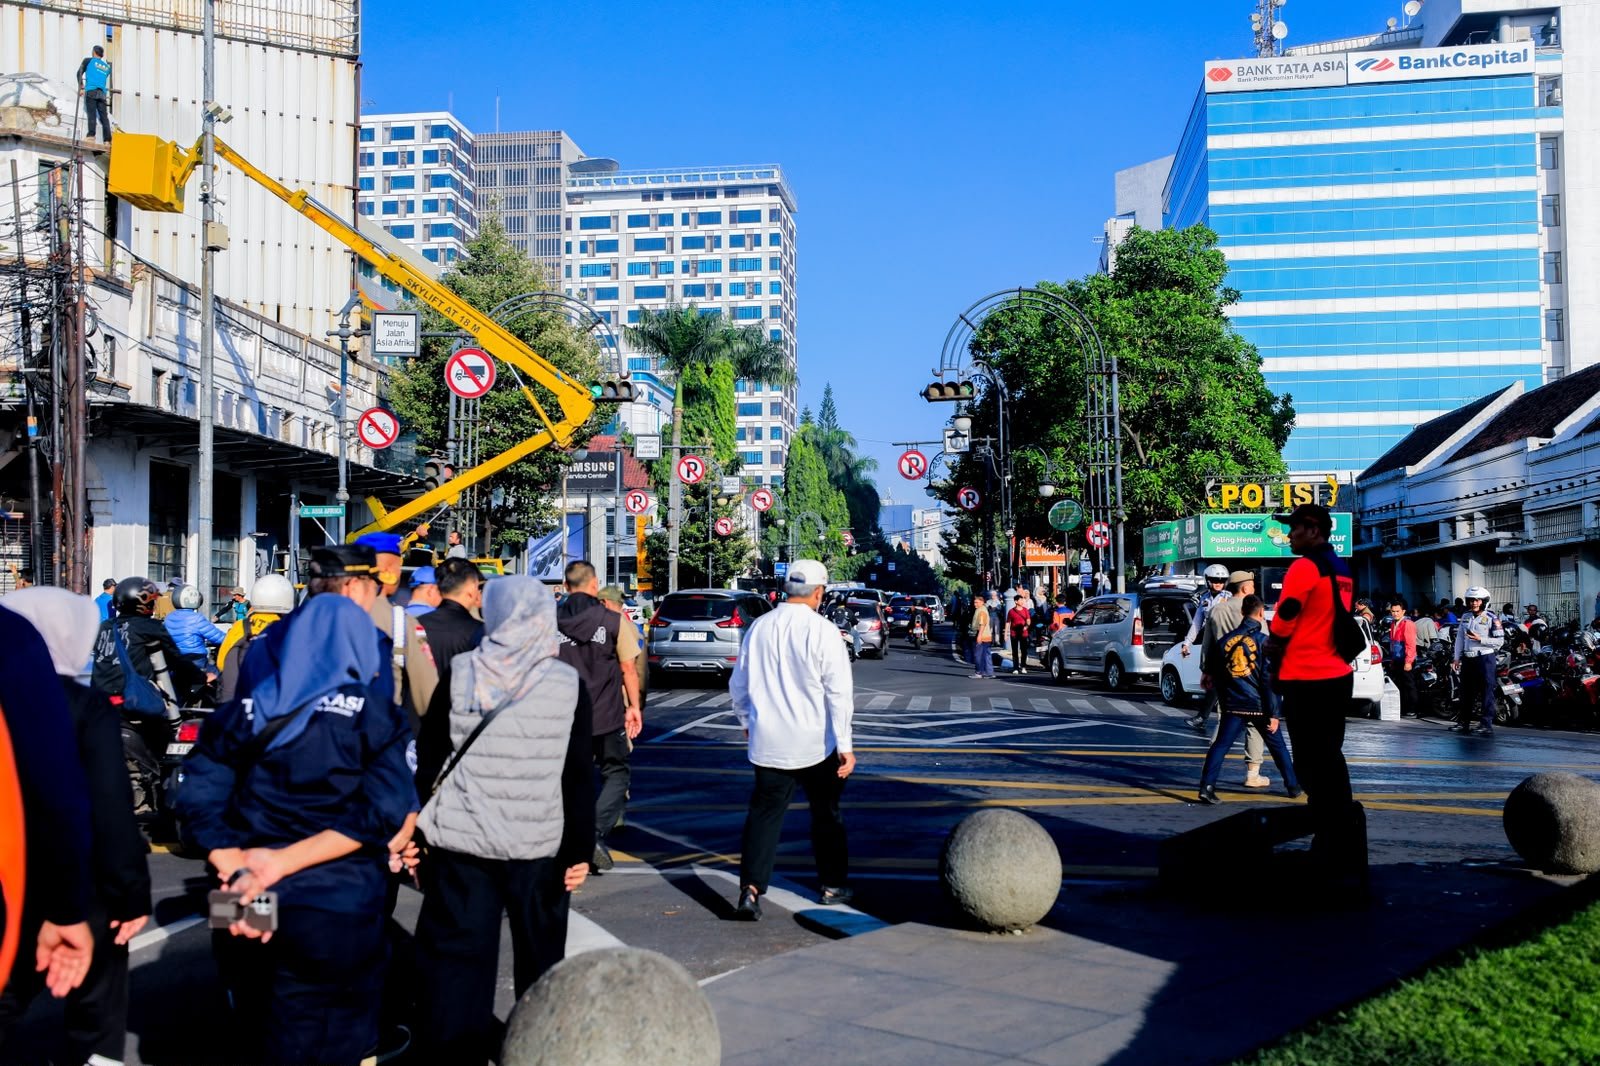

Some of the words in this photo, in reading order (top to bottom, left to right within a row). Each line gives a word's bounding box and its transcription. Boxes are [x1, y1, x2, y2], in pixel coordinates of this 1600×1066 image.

[1399, 48, 1528, 69] BankCapital
[1237, 64, 1272, 77] BANK
[1276, 63, 1309, 75] TATA
[1313, 60, 1345, 73] ASIA
[405, 278, 445, 307] SKYLIFT
[444, 306, 458, 317] AT
[460, 315, 471, 327] 18
[470, 324, 481, 334] M
[383, 320, 409, 329] Menuju
[376, 339, 393, 347] Asia
[394, 339, 415, 347] Afrika
[1211, 520, 1261, 530] GrabFood
[1210, 536, 1235, 545] Paling
[1236, 545, 1257, 554] Jajan
